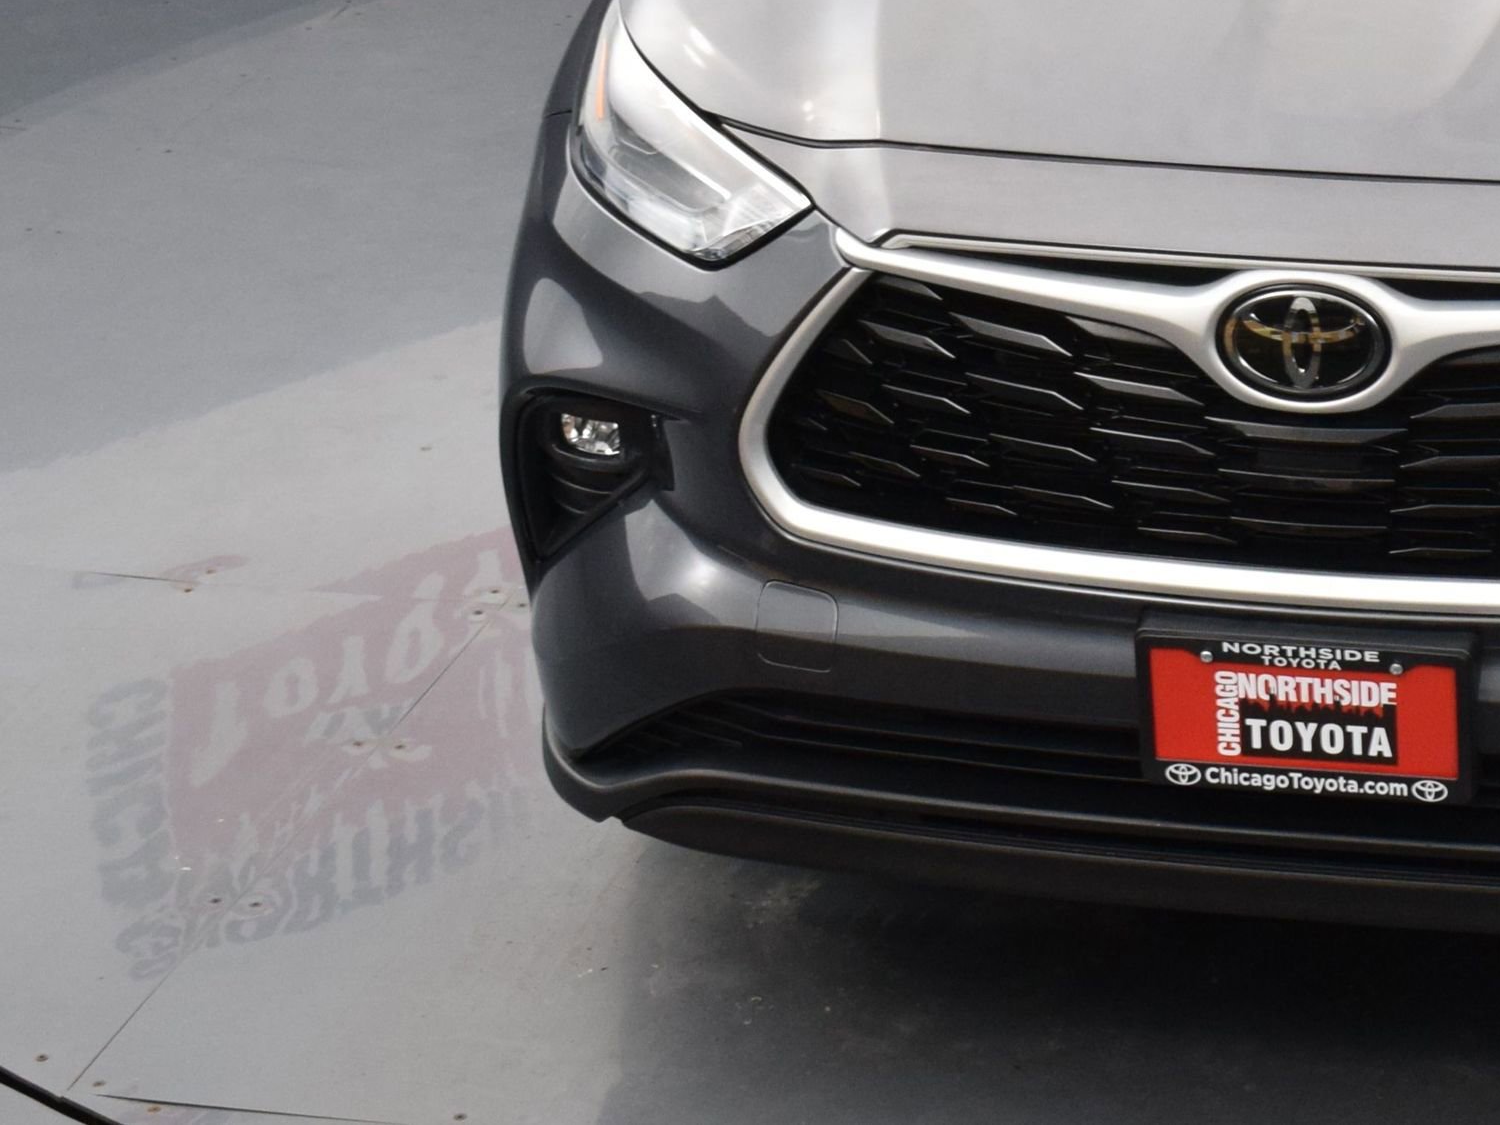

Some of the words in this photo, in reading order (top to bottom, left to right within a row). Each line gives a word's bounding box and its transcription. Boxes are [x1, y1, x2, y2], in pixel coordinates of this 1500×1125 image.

[1221, 641, 1381, 663] NORTHSIDE
[1260, 655, 1342, 671] TOYOTA
[1236, 672, 1398, 708] NORTHSIDE
[1214, 670, 1242, 757] CHICAGO
[1245, 718, 1393, 758] TOYOTA
[1204, 766, 1409, 797] ChicagoToyota.com
